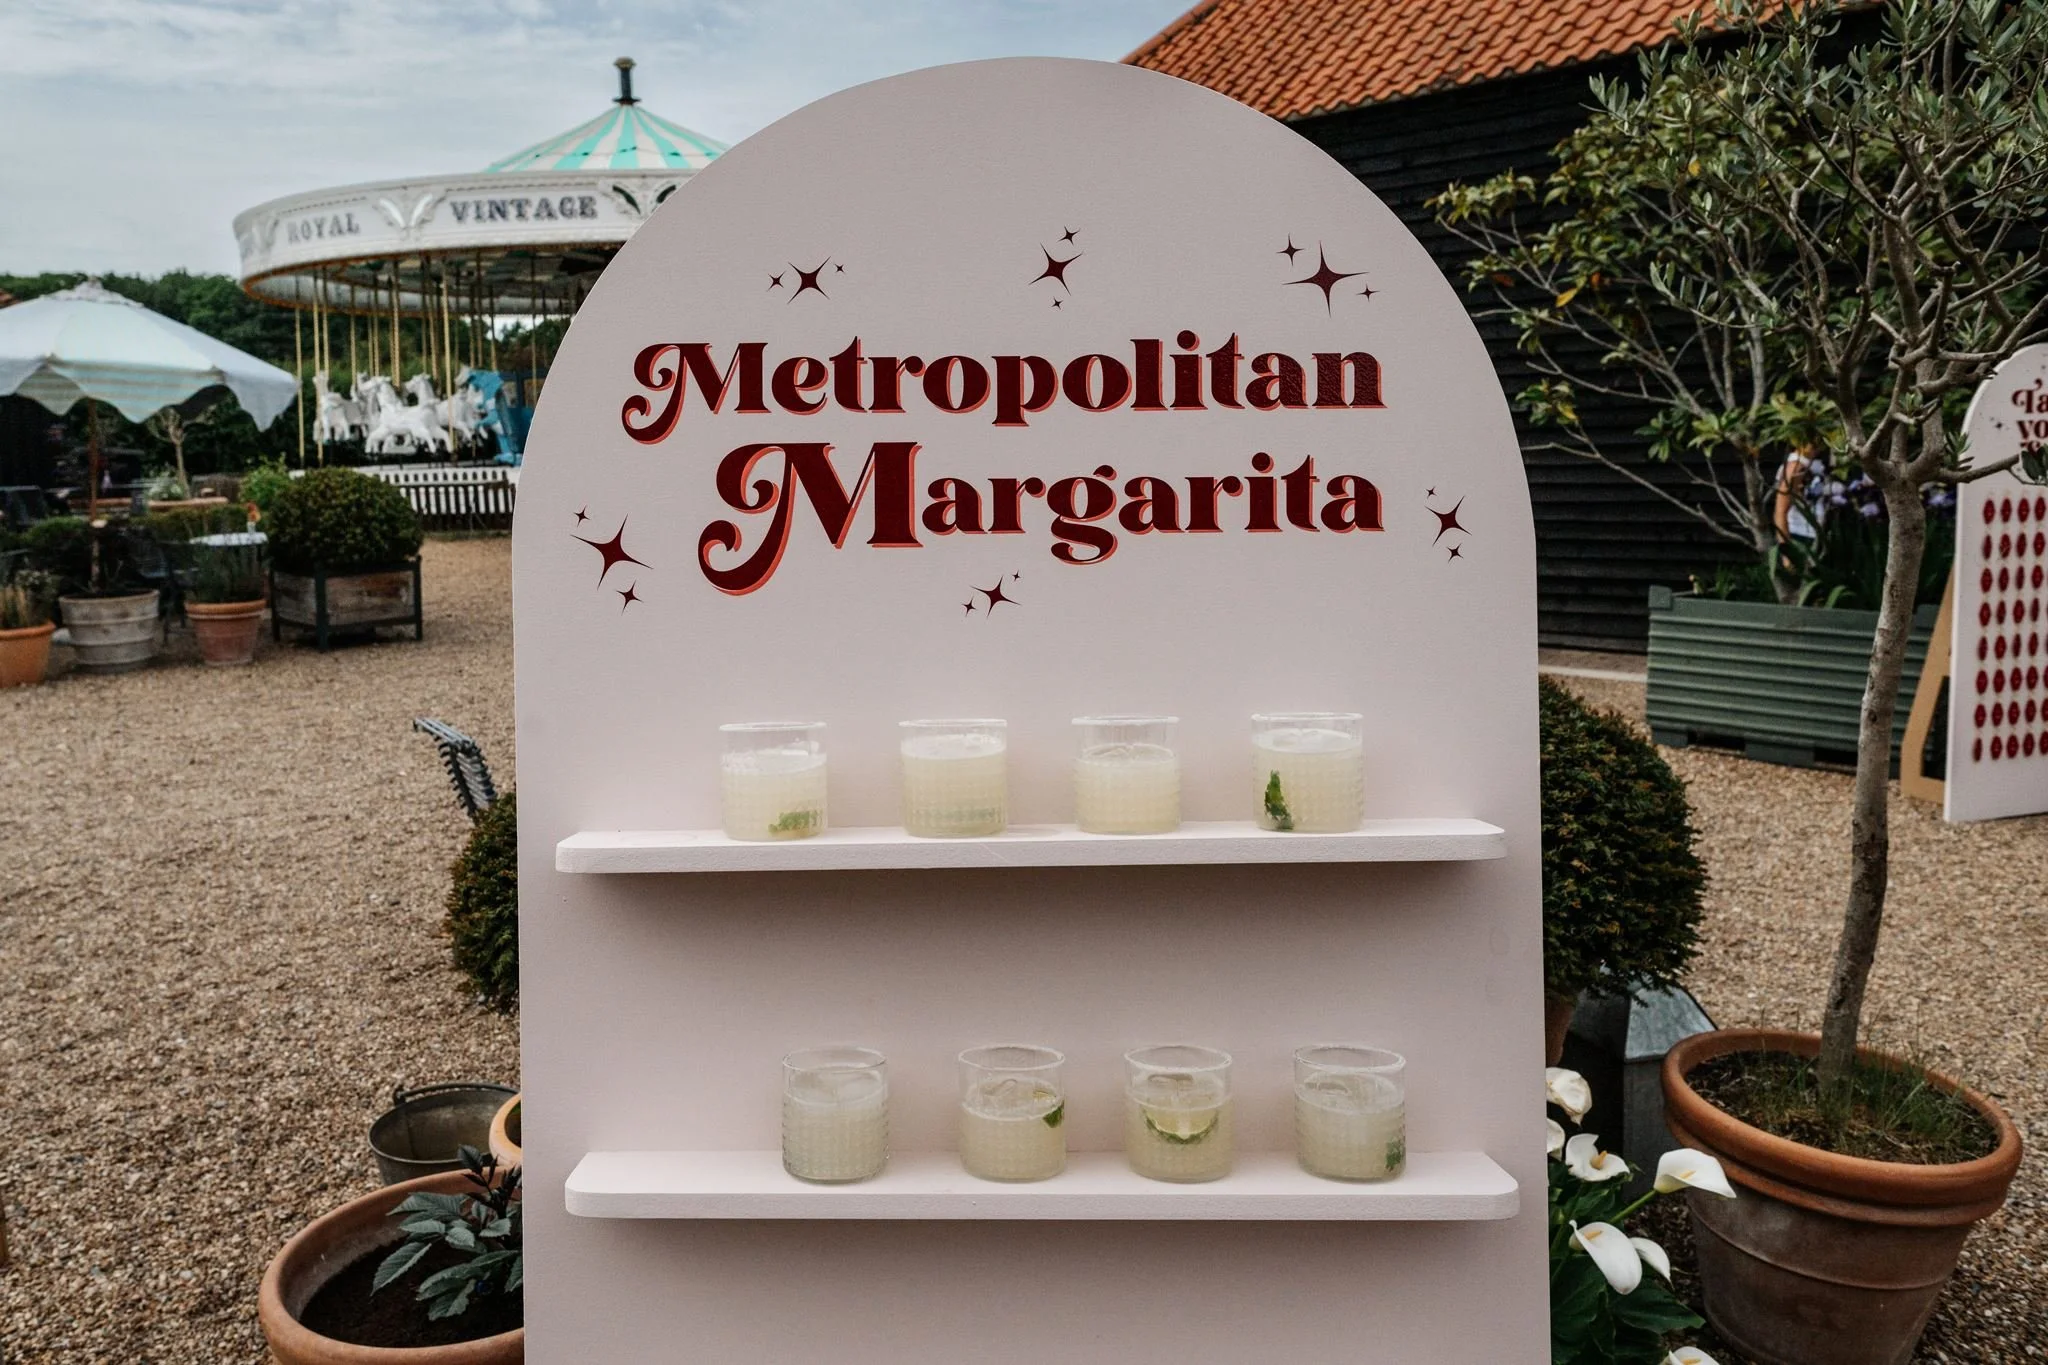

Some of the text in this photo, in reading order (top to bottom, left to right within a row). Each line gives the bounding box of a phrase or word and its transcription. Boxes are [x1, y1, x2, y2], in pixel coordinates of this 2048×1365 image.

[286, 195, 598, 245] ROYAL VINTAGE
[621, 329, 1388, 444] Metropolitan
[697, 440, 1385, 597] Margarita
